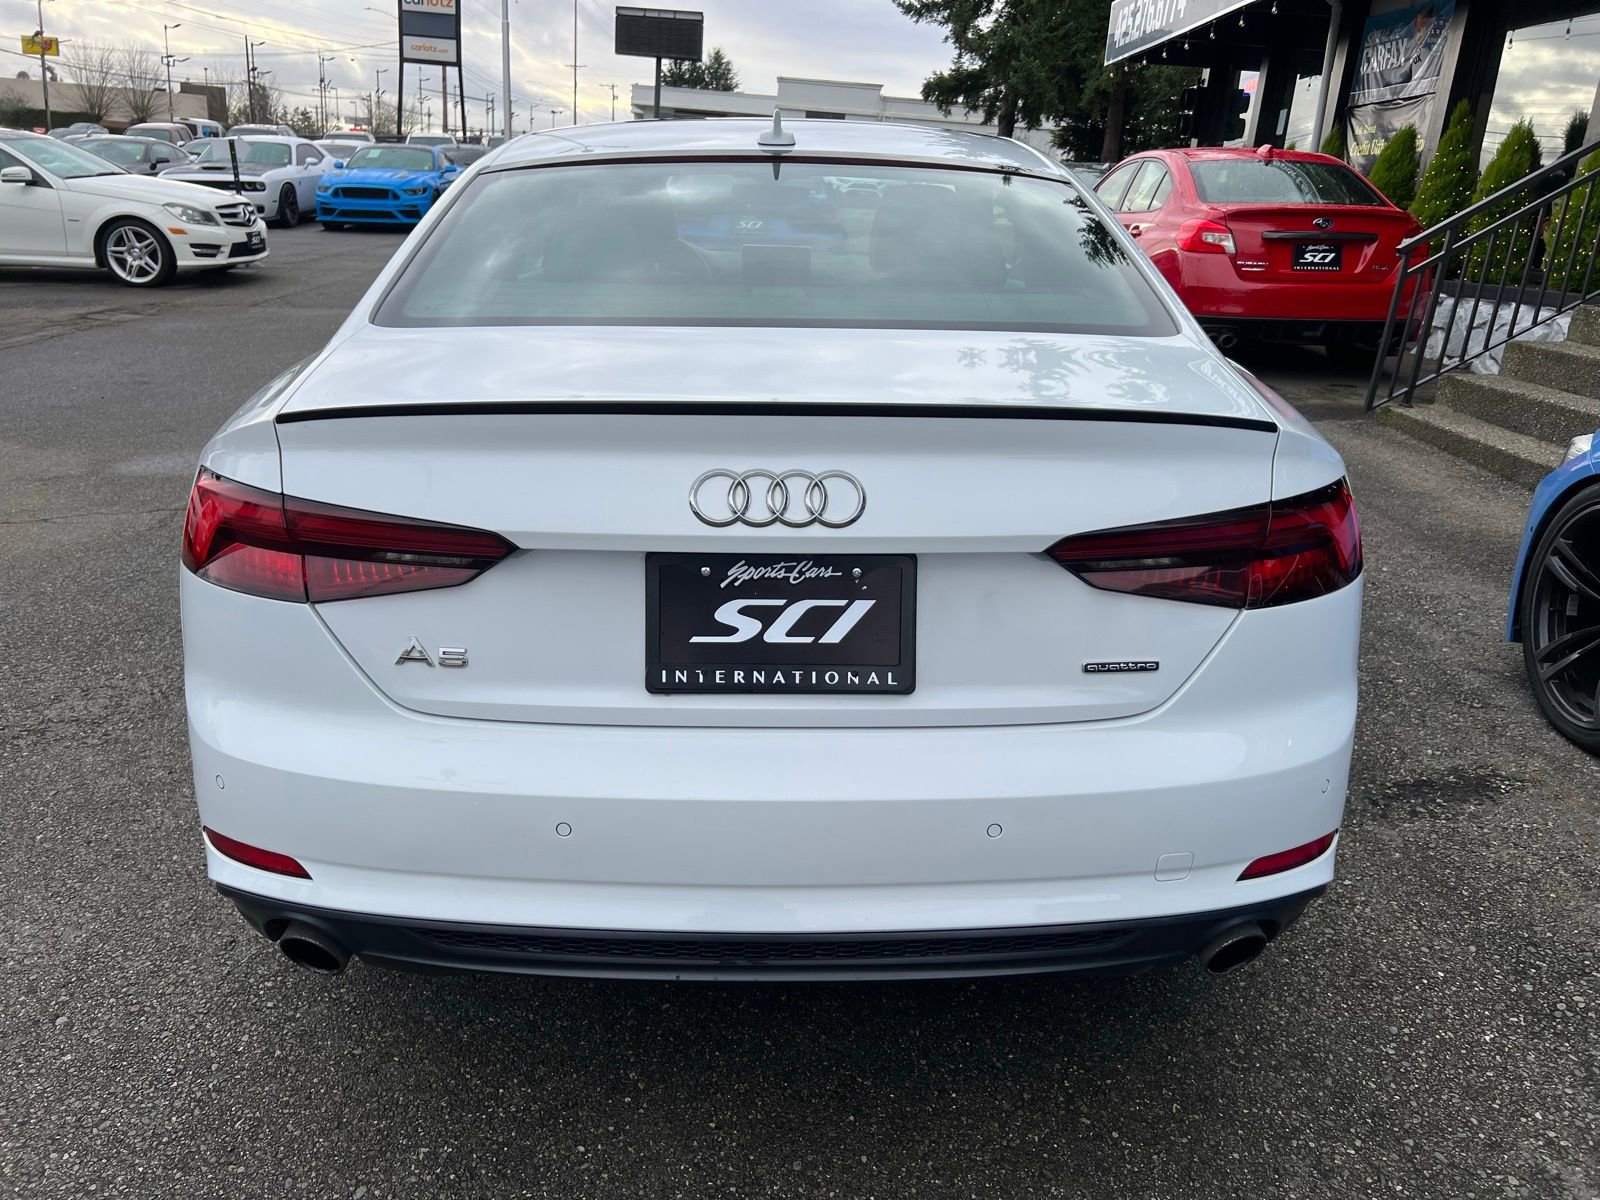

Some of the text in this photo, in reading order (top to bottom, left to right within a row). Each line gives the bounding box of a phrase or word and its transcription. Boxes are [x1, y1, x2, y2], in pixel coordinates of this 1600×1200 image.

[1298, 252, 1336, 263] SCI
[720, 560, 843, 588] Sports Cars
[688, 598, 877, 644] SCI
[393, 635, 469, 669] A5
[661, 669, 898, 685] INTERNATIONAL
[1086, 662, 1157, 671] quattro
